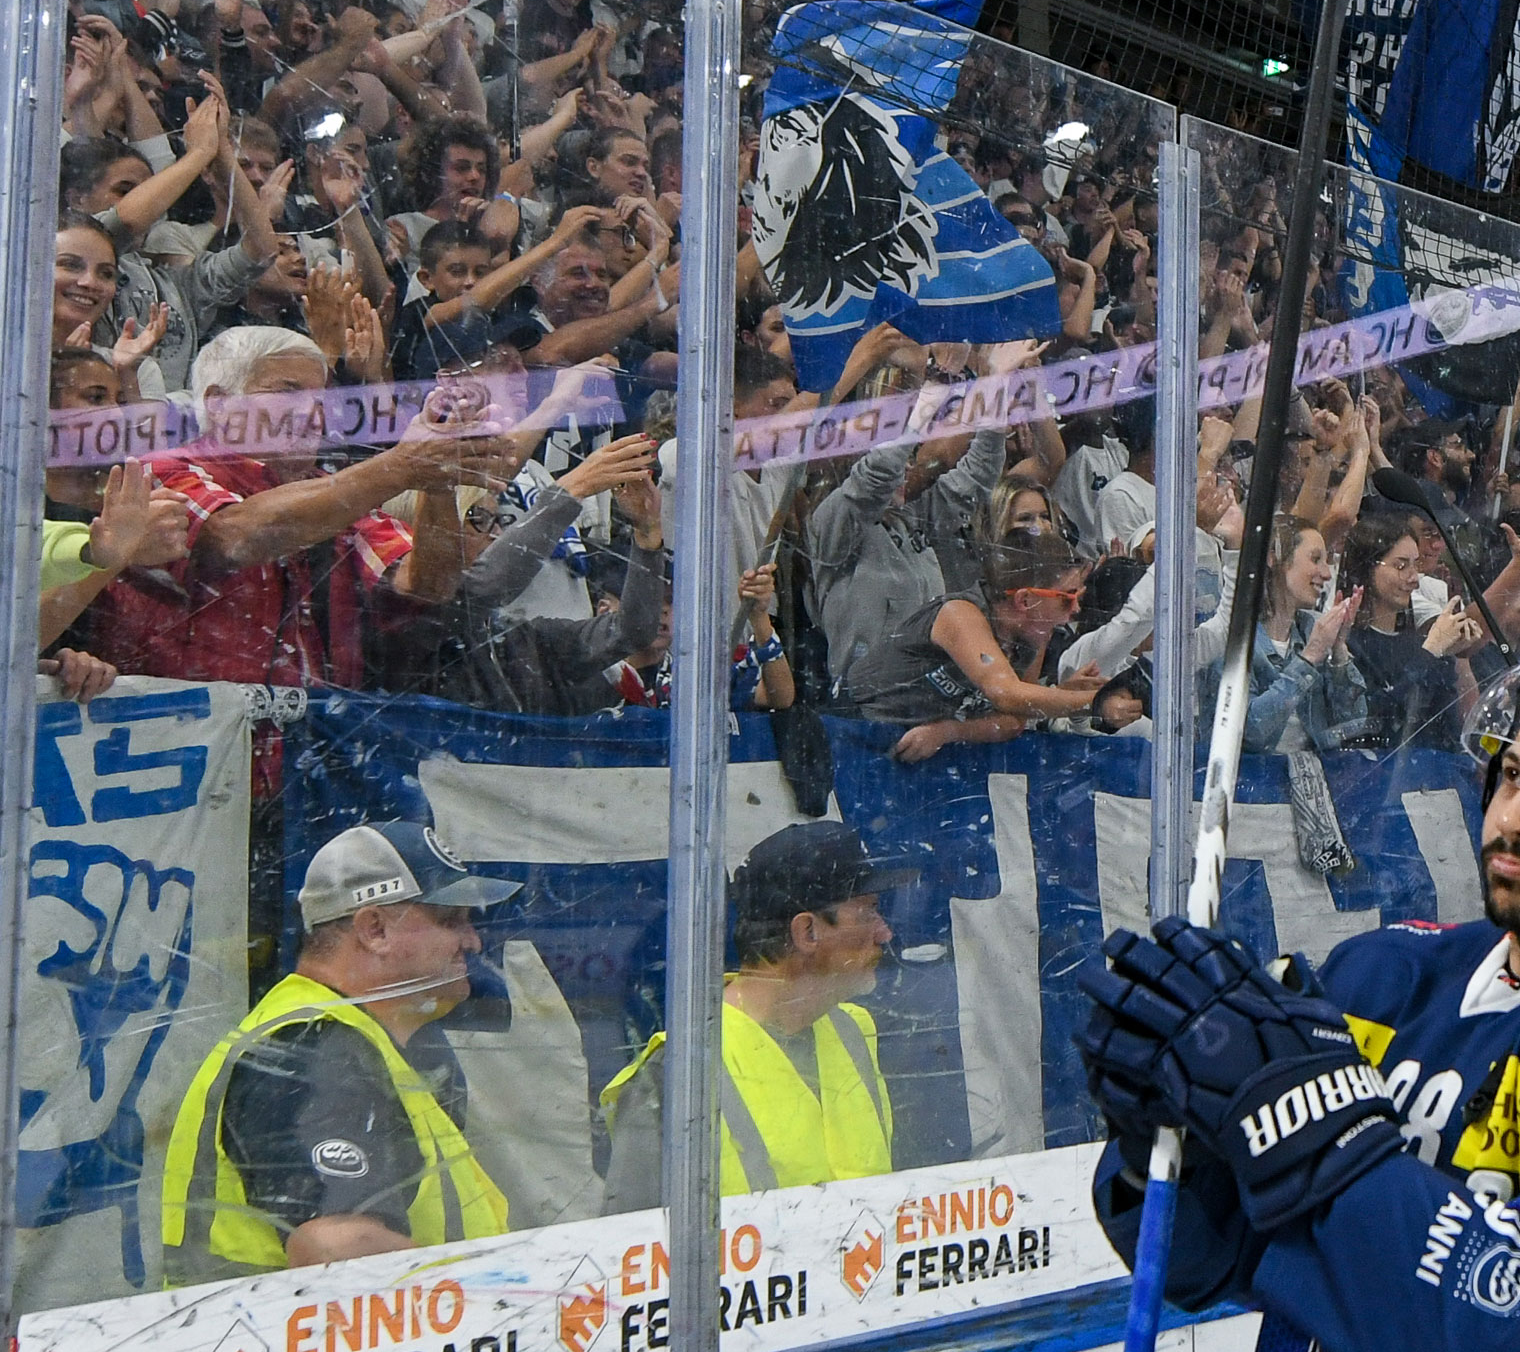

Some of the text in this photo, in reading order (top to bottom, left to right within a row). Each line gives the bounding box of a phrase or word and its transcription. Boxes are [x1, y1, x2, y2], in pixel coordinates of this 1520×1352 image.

[352, 877, 403, 904] 1937
[896, 1183, 1016, 1245] ENNIO
[1415, 1191, 1473, 1288] ANNI
[895, 1226, 1052, 1298] FERRARI
